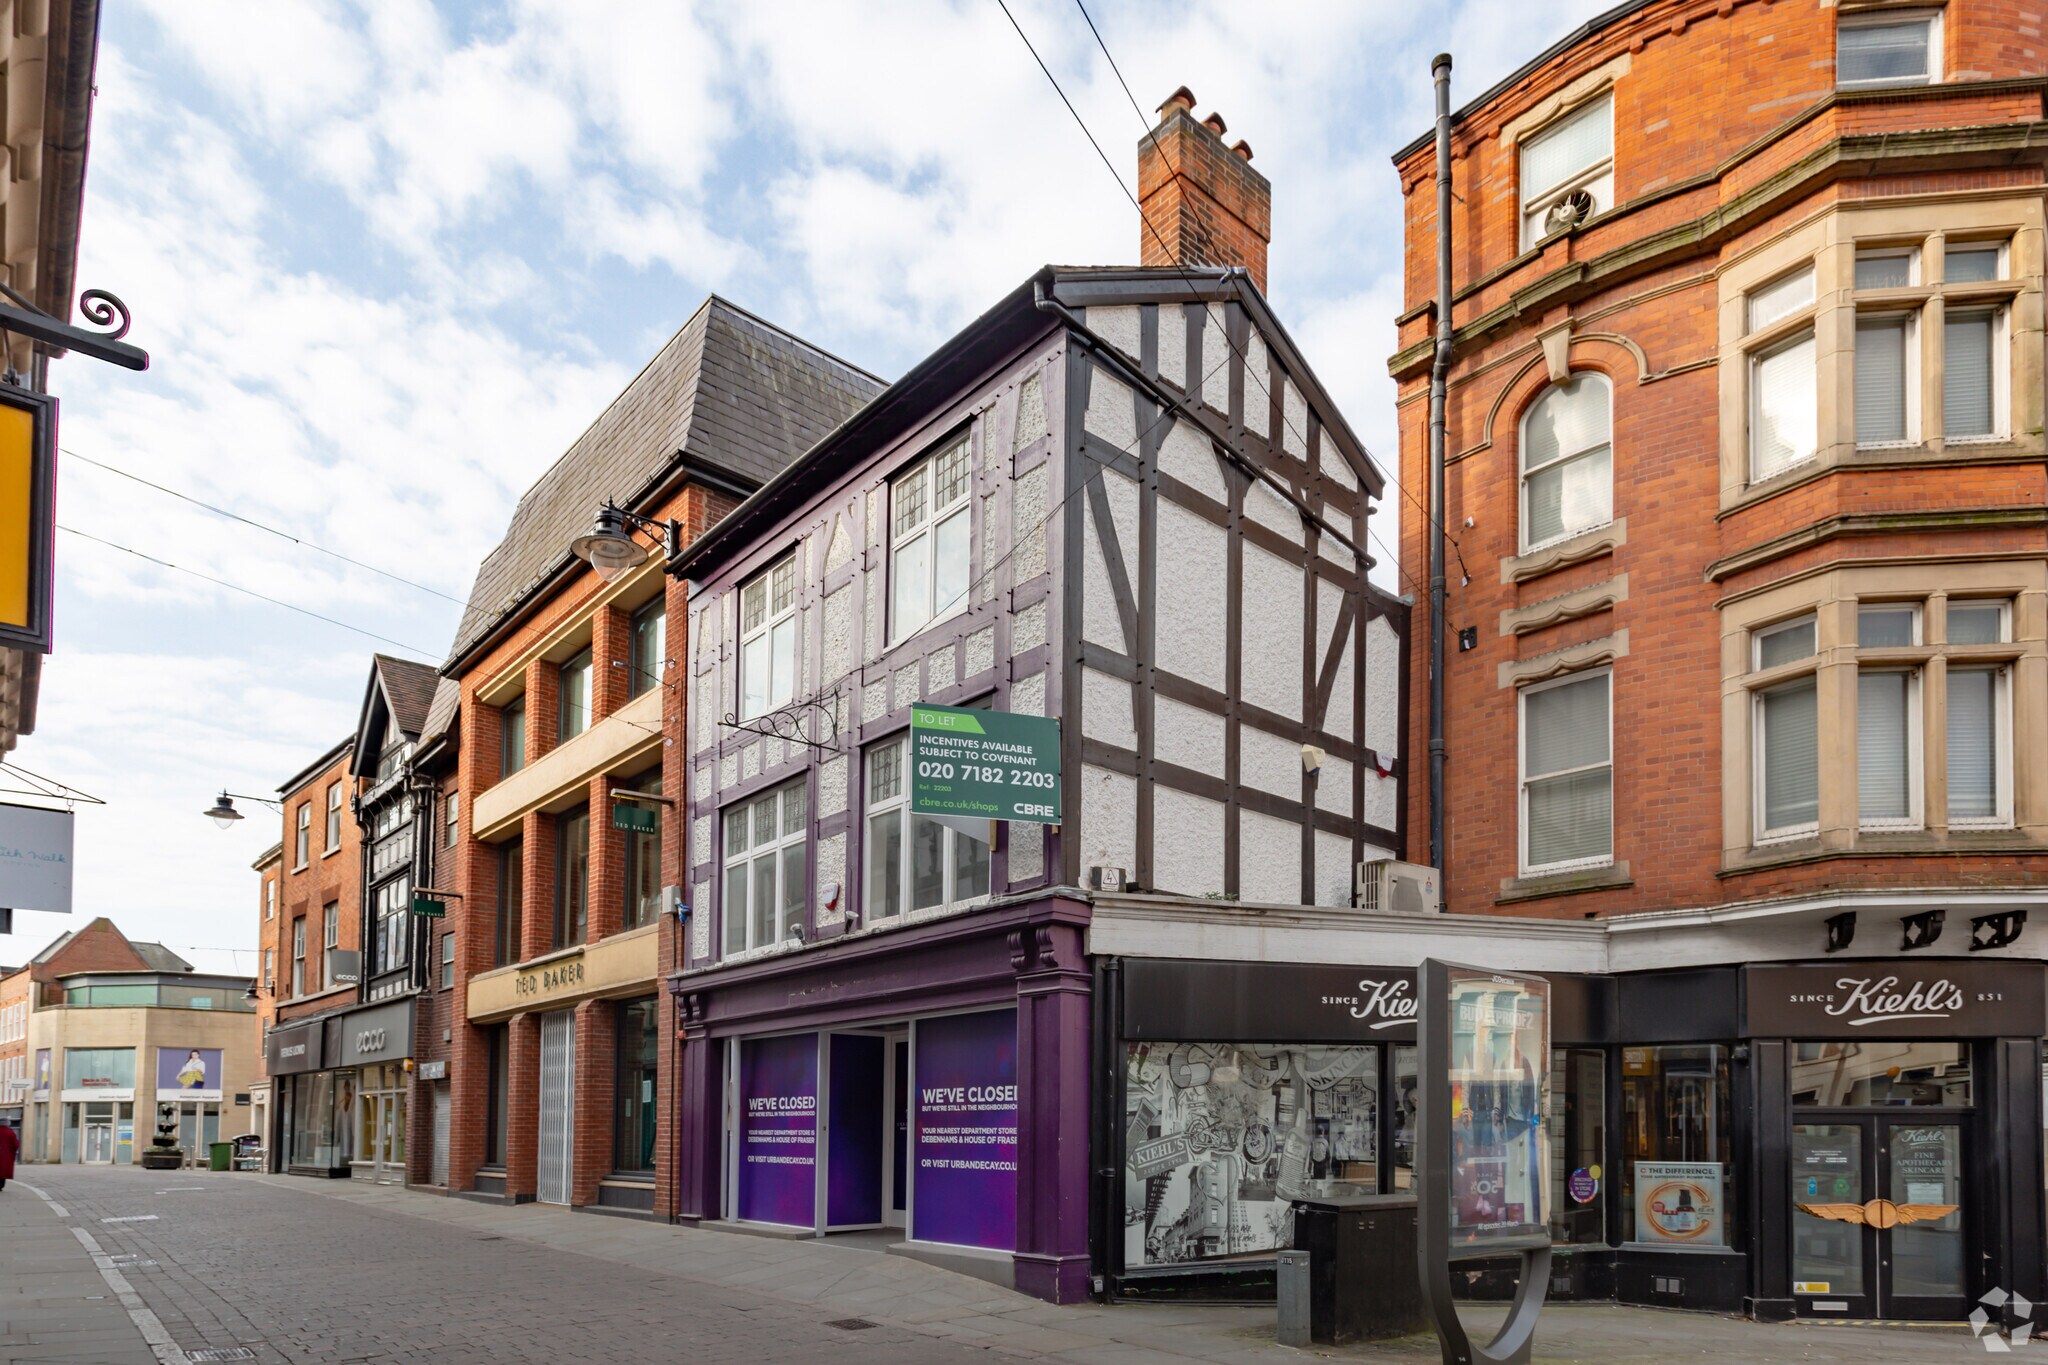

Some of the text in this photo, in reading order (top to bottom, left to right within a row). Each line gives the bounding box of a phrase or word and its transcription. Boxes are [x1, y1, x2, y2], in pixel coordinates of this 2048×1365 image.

[919, 713, 956, 726] TO LET
[919, 735, 1033, 754] INCENTIVES AVAILABLE
[919, 747, 1037, 766] SUBJECT TO COVENANT
[918, 761, 1055, 788] 020 7182 2203
[919, 797, 1054, 817] cbre.co.uk/shops CBRE
[615, 821, 654, 833] TED BAKER
[335, 973, 358, 982] ecco
[516, 963, 583, 995] TED BAKER
[1321, 996, 1358, 1005] SINCE
[1790, 994, 1834, 1003] SINCE
[1824, 976, 1963, 1016] Kiehl's
[356, 1028, 386, 1053] ecco
[922, 1085, 1017, 1103] WE'VE CLOSE
[749, 1096, 816, 1110] WE'VE CLOSED
[998, 1127, 1017, 1135] STORE
[1901, 1129, 1946, 1143] Kiehl's
[921, 1135, 1017, 1144] DEBENHAMS & HOUSE OF FRASE
[1136, 1139, 1185, 1165] KIEHL'S
[1914, 1151, 1936, 1159] FINE
[767, 1156, 815, 1165] URBANDECAY.CO.UK
[921, 1159, 1017, 1171] OR VISIT URBANDECAY.CO.U
